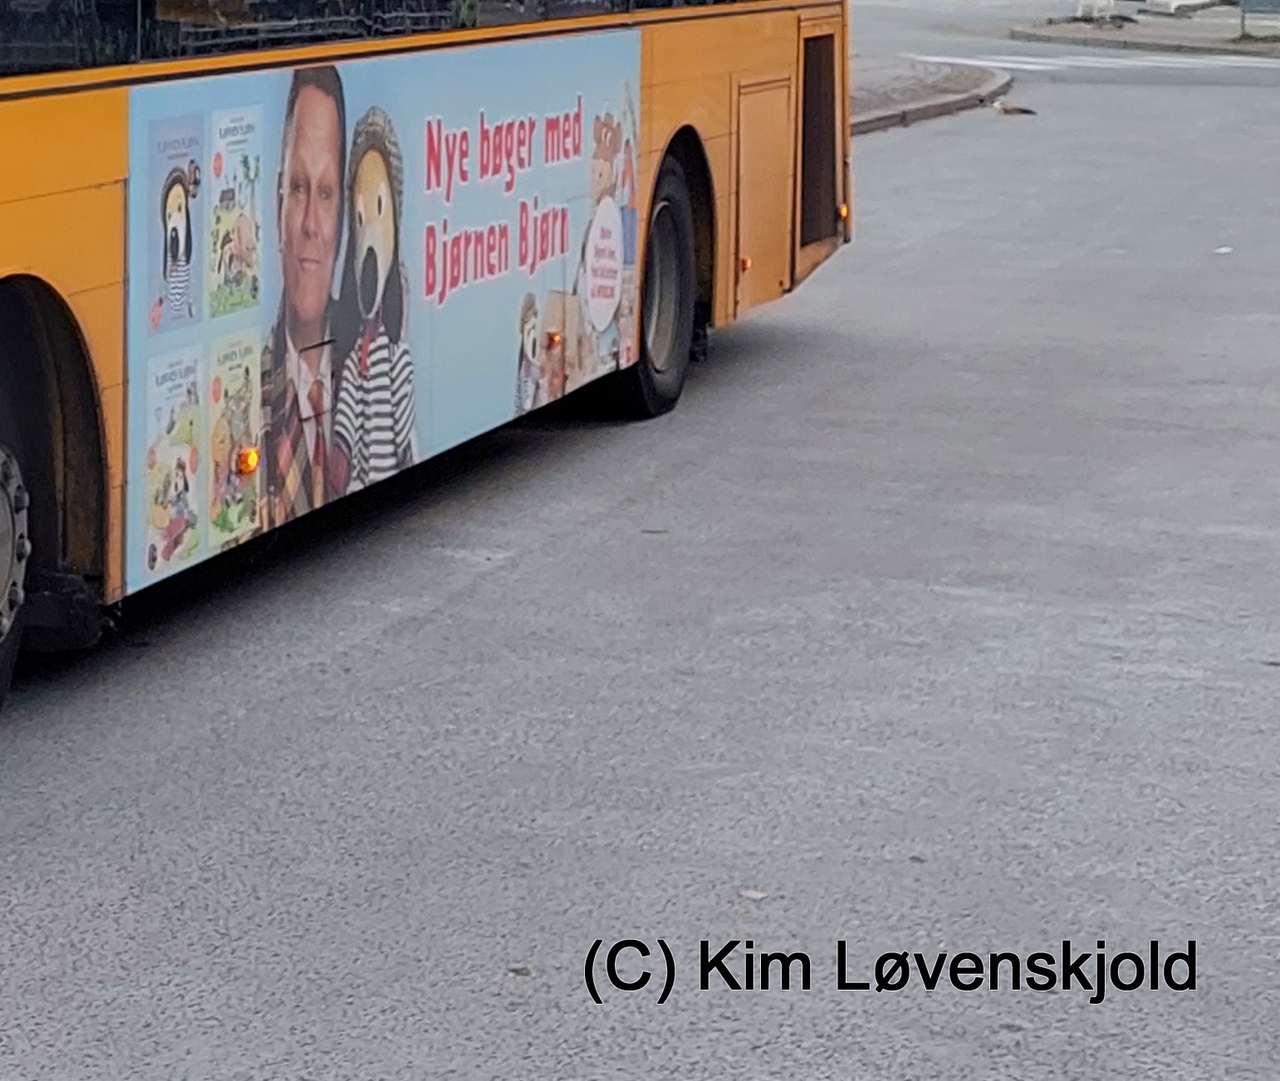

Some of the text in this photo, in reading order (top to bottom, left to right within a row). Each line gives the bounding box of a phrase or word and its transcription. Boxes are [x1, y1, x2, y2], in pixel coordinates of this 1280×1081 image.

[424, 94, 582, 203] Nye bøger med
[424, 218, 509, 306] Bjørnen
[517, 195, 569, 276] Bjørn
